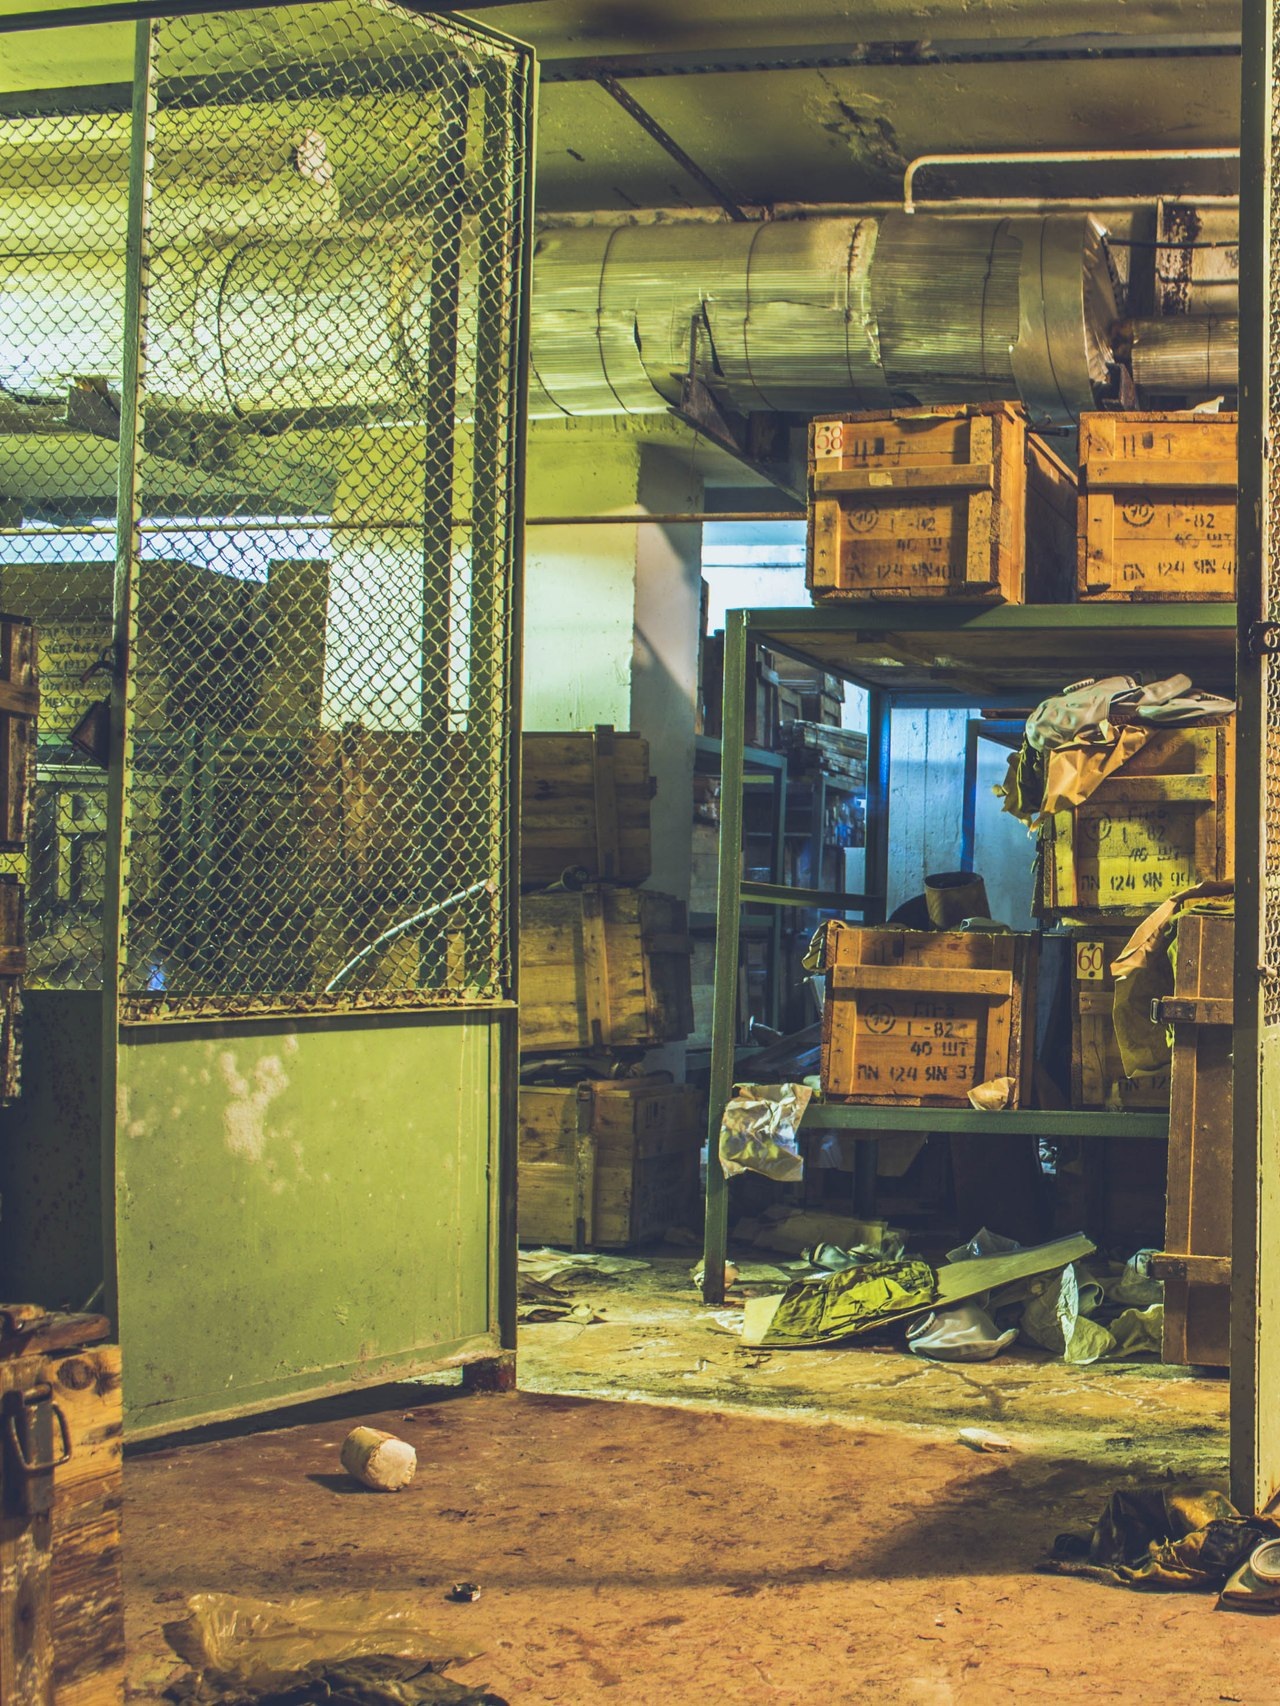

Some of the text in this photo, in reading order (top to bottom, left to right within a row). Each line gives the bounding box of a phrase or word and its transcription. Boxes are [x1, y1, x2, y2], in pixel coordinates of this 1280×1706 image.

[817, 427, 843, 450] 58
[1110, 874, 1136, 891] 124
[1078, 947, 1103, 971] 60
[942, 1041, 969, 1057] ШТ
[889, 1066, 918, 1082] 124
